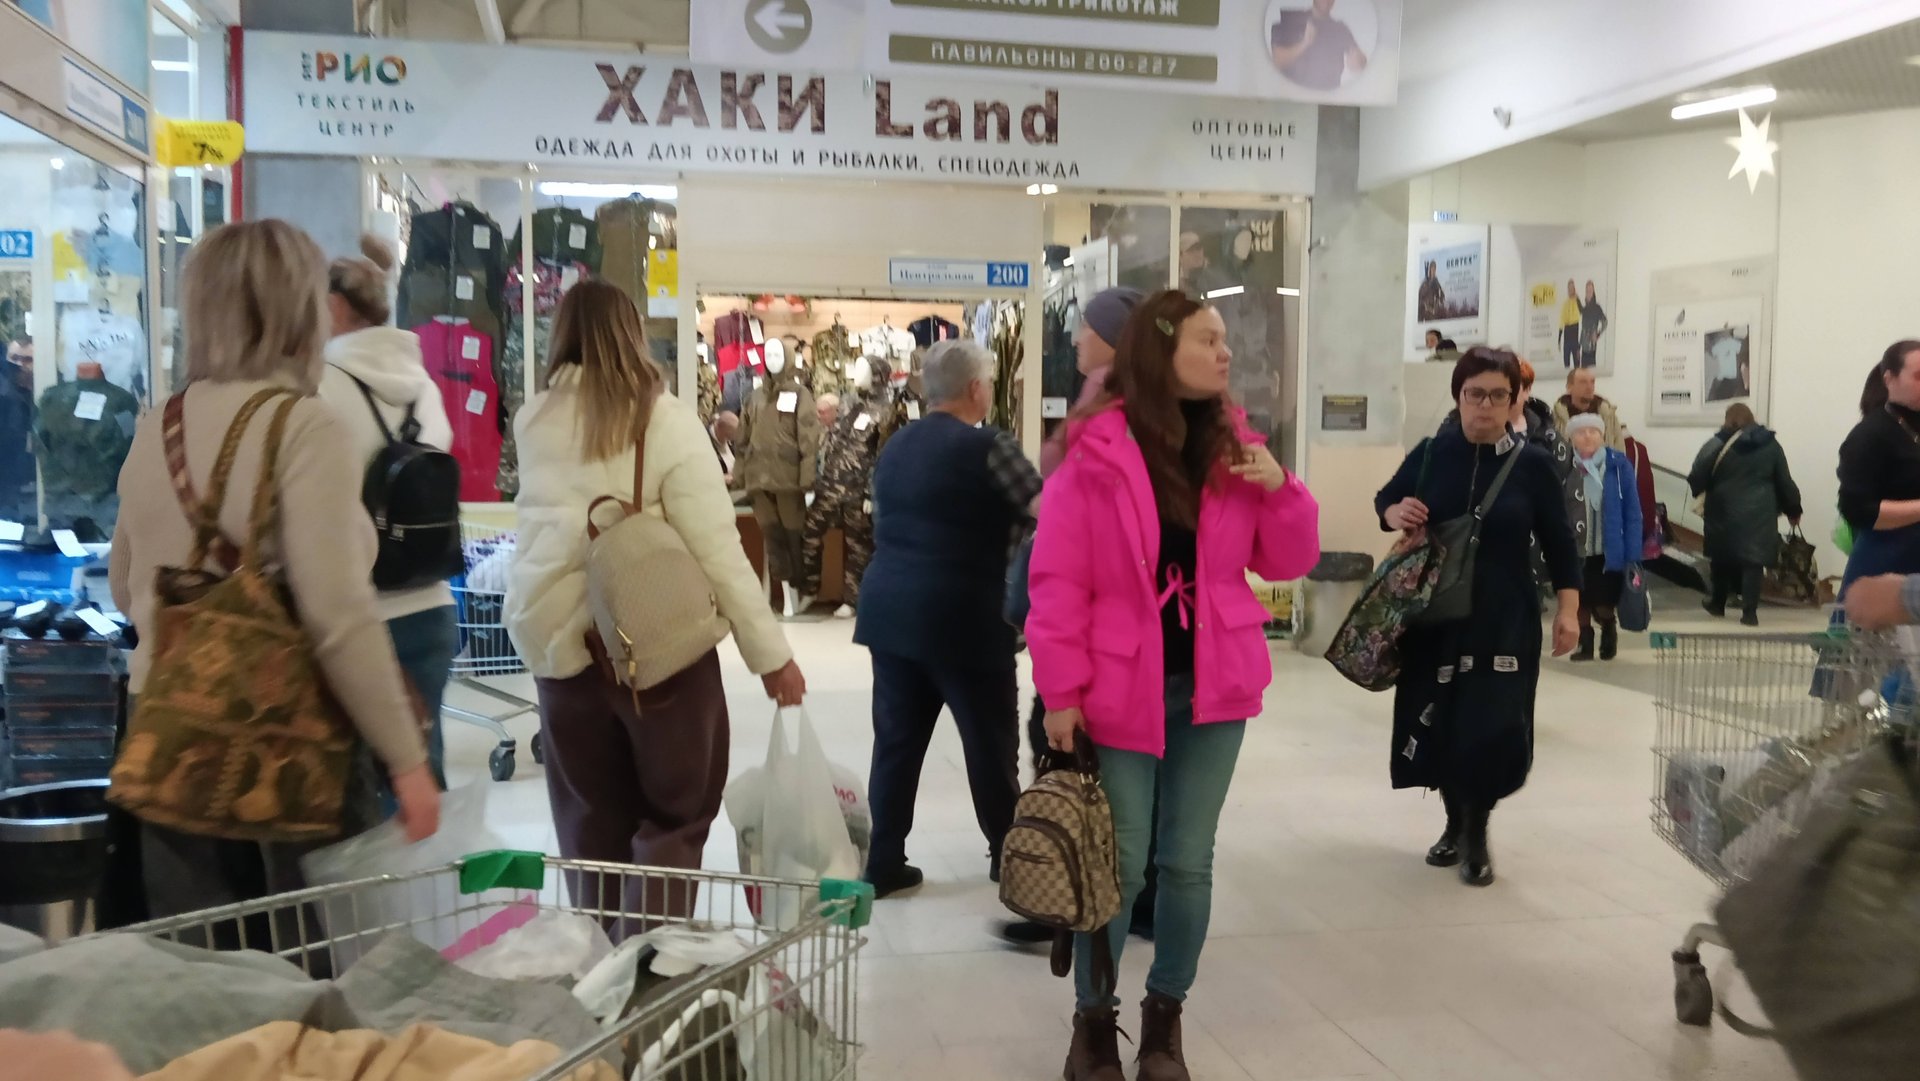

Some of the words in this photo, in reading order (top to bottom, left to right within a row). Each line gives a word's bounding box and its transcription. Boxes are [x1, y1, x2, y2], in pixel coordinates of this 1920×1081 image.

[315, 51, 407, 85] РИО
[931, 41, 1076, 69] ПАВИЛЬОНЫ
[1084, 53, 1177, 76] 200-227
[296, 91, 415, 113] ТЕКСТИЛЬ
[595, 63, 826, 134] ХАКИ
[875, 79, 1059, 146] Land
[318, 119, 394, 137] ЦЕНТР
[1192, 119, 1297, 138] ОПТОВЫЕ
[535, 134, 635, 160] ОДЕЖДА
[647, 142, 692, 161] ДЛЯ
[706, 144, 779, 165] ОХОТЫ
[792, 148, 805, 166] И
[818, 149, 924, 172] РЫБАЛКИ,
[938, 153, 1080, 179] СПЕЦОДЕЖДА
[1210, 143, 1285, 161] ЦЕНЫ!
[992, 264, 1024, 286] 200
